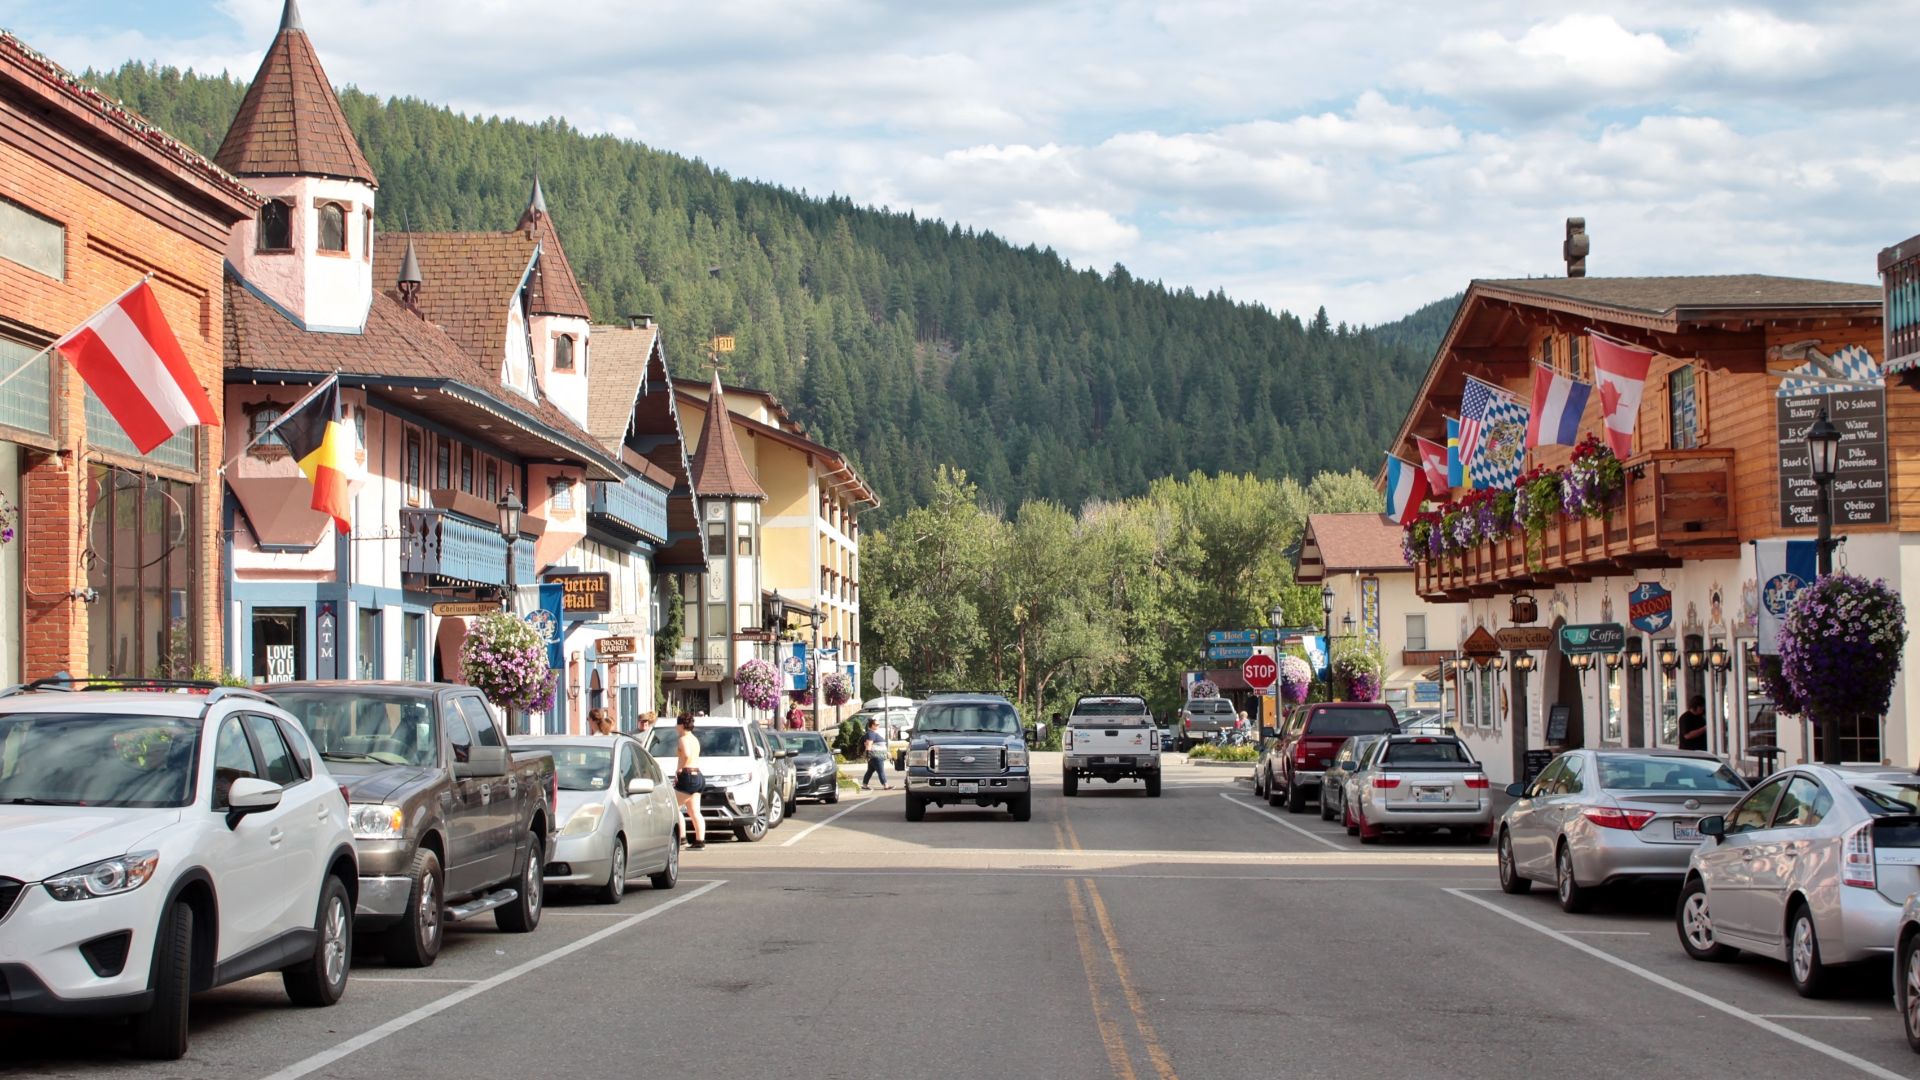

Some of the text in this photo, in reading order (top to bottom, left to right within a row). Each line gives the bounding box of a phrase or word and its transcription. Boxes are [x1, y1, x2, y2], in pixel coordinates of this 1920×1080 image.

[1836, 399, 1877, 411] PO Saloon
[1790, 408, 1816, 418] Bakery
[1845, 420, 1869, 430] Water
[1857, 430, 1878, 439] Wine
[1848, 447, 1867, 459] Pika
[1782, 457, 1801, 468] Basel
[1839, 457, 1877, 469] Provisions
[1788, 477, 1817, 488] Patters
[1834, 478, 1883, 492] Sigillo Cellars
[1844, 500, 1875, 510] Obelisco
[1848, 511, 1872, 520] Estate
[563, 593, 596, 609] Mall
[1630, 596, 1671, 618] SALOON
[439, 604, 476, 613] Edelweiss
[321, 617, 333, 658] ATM
[1224, 631, 1243, 641] Hotel
[1498, 632, 1551, 644] Wine Cellar
[1589, 629, 1621, 643] Coffee
[266, 645, 294, 659] LOVE
[267, 659, 295, 675] YOU
[1245, 665, 1275, 679] STOP
